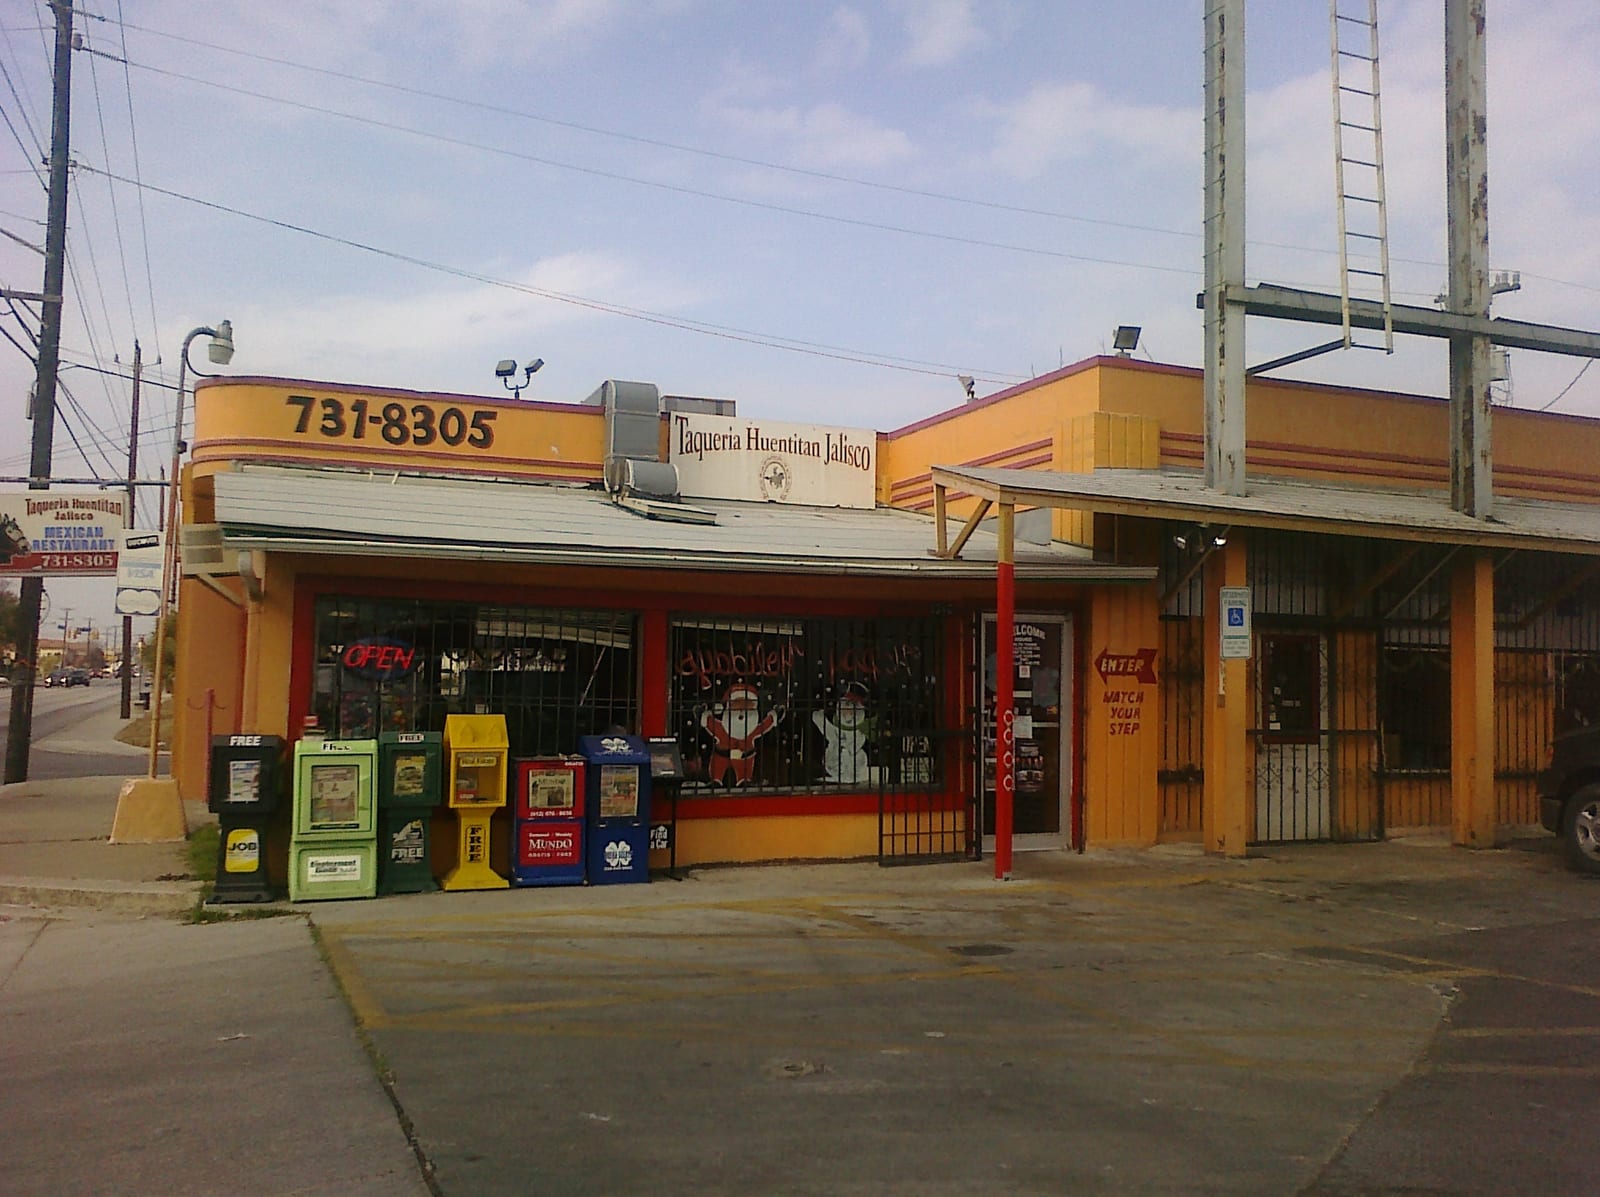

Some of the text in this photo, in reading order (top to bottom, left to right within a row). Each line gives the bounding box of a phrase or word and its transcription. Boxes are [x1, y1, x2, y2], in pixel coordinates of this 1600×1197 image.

[286, 395, 497, 449] 731-8305
[675, 415, 870, 471] Taqueria Huentitan Jalisco
[25, 498, 122, 516] Taqueria Huentitan
[54, 512, 94, 521] Jalisco
[45, 527, 103, 538] MEXICAN
[32, 539, 115, 551] RESTAURANT
[41, 555, 113, 567] 731-8305
[344, 643, 415, 670] OPEN
[1100, 657, 1144, 674] ENTER
[1103, 691, 1144, 704] WATCH
[1110, 707, 1141, 720] YOUR
[1109, 722, 1139, 736] STEP
[230, 735, 262, 746] FREE
[650, 829, 668, 840] Find
[228, 842, 258, 852] JOB
[469, 827, 483, 863] FREE
[529, 839, 573, 849] MUNDO
[656, 839, 668, 849] Car
[391, 848, 424, 859] FREE
